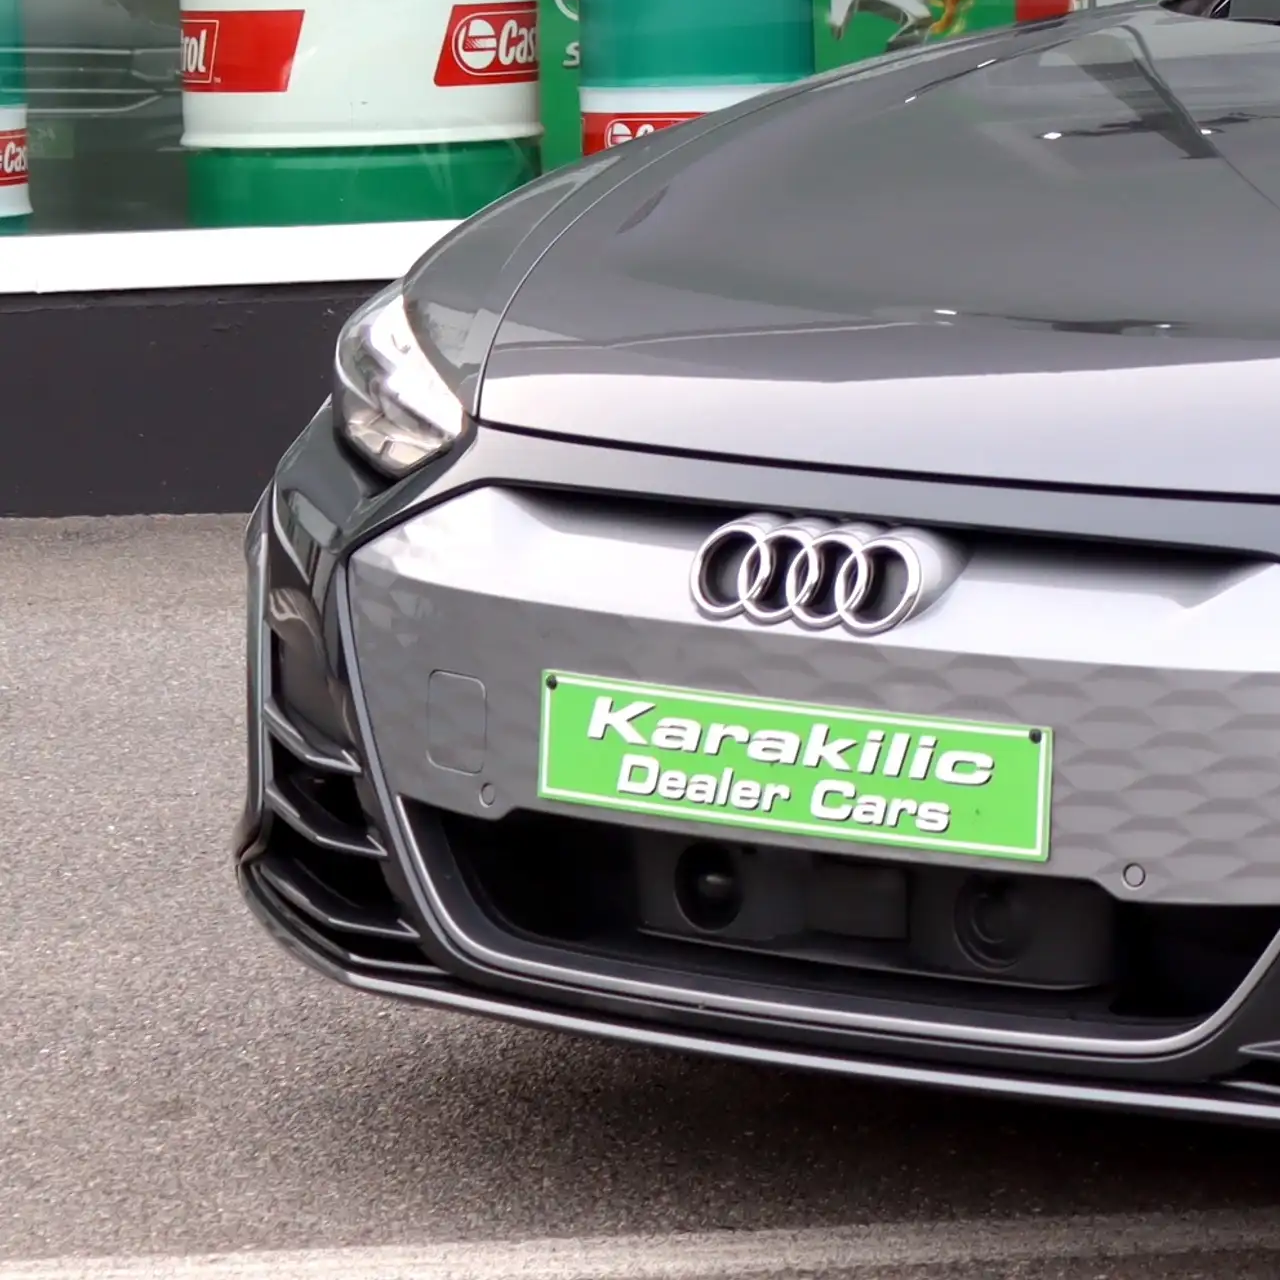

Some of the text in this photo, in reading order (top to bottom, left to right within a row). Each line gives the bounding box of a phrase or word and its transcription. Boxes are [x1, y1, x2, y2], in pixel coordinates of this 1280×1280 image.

[180, 28, 207, 74] rol
[497, 19, 538, 66] Cas
[585, 695, 998, 787] Karakilic
[615, 753, 953, 834] Dealer Cars
